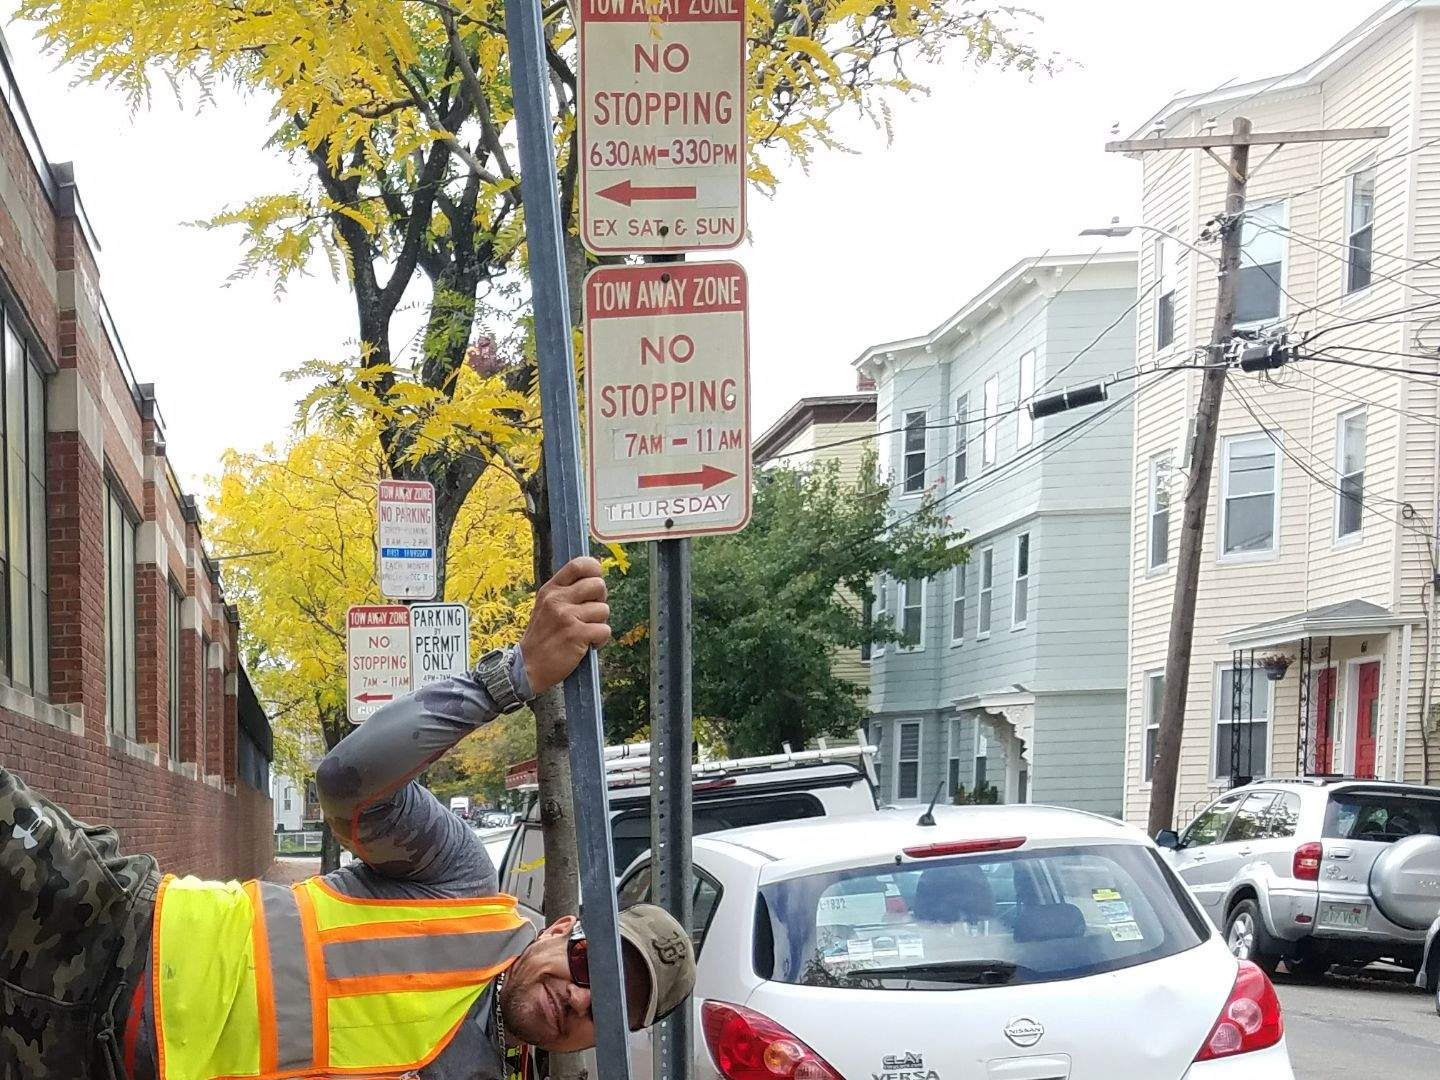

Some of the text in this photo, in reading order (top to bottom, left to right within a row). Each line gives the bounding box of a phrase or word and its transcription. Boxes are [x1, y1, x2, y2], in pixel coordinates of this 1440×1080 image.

[634, 43, 690, 73] NO
[593, 91, 732, 126] STOPPING
[594, 218, 735, 237] EX SAT & SUN
[592, 276, 741, 311] TOW AWAY ZONE
[640, 335, 696, 365] NO
[601, 378, 736, 418] STOPPING
[625, 433, 663, 458] 7AM
[380, 485, 394, 500] TOW
[414, 487, 432, 501] ZONE
[381, 506, 431, 524] NO PARKING
[604, 495, 730, 520] THURSDAY
[350, 611, 408, 625] TOW AWAY ZONE
[414, 609, 461, 627] PARKING
[369, 636, 390, 648] NO
[416, 635, 461, 653] PERMIT
[353, 655, 407, 670] STOPPING
[423, 654, 454, 671] ONLY
[363, 676, 378, 688] 7AM
[883, 1052, 923, 1065] CLAY
